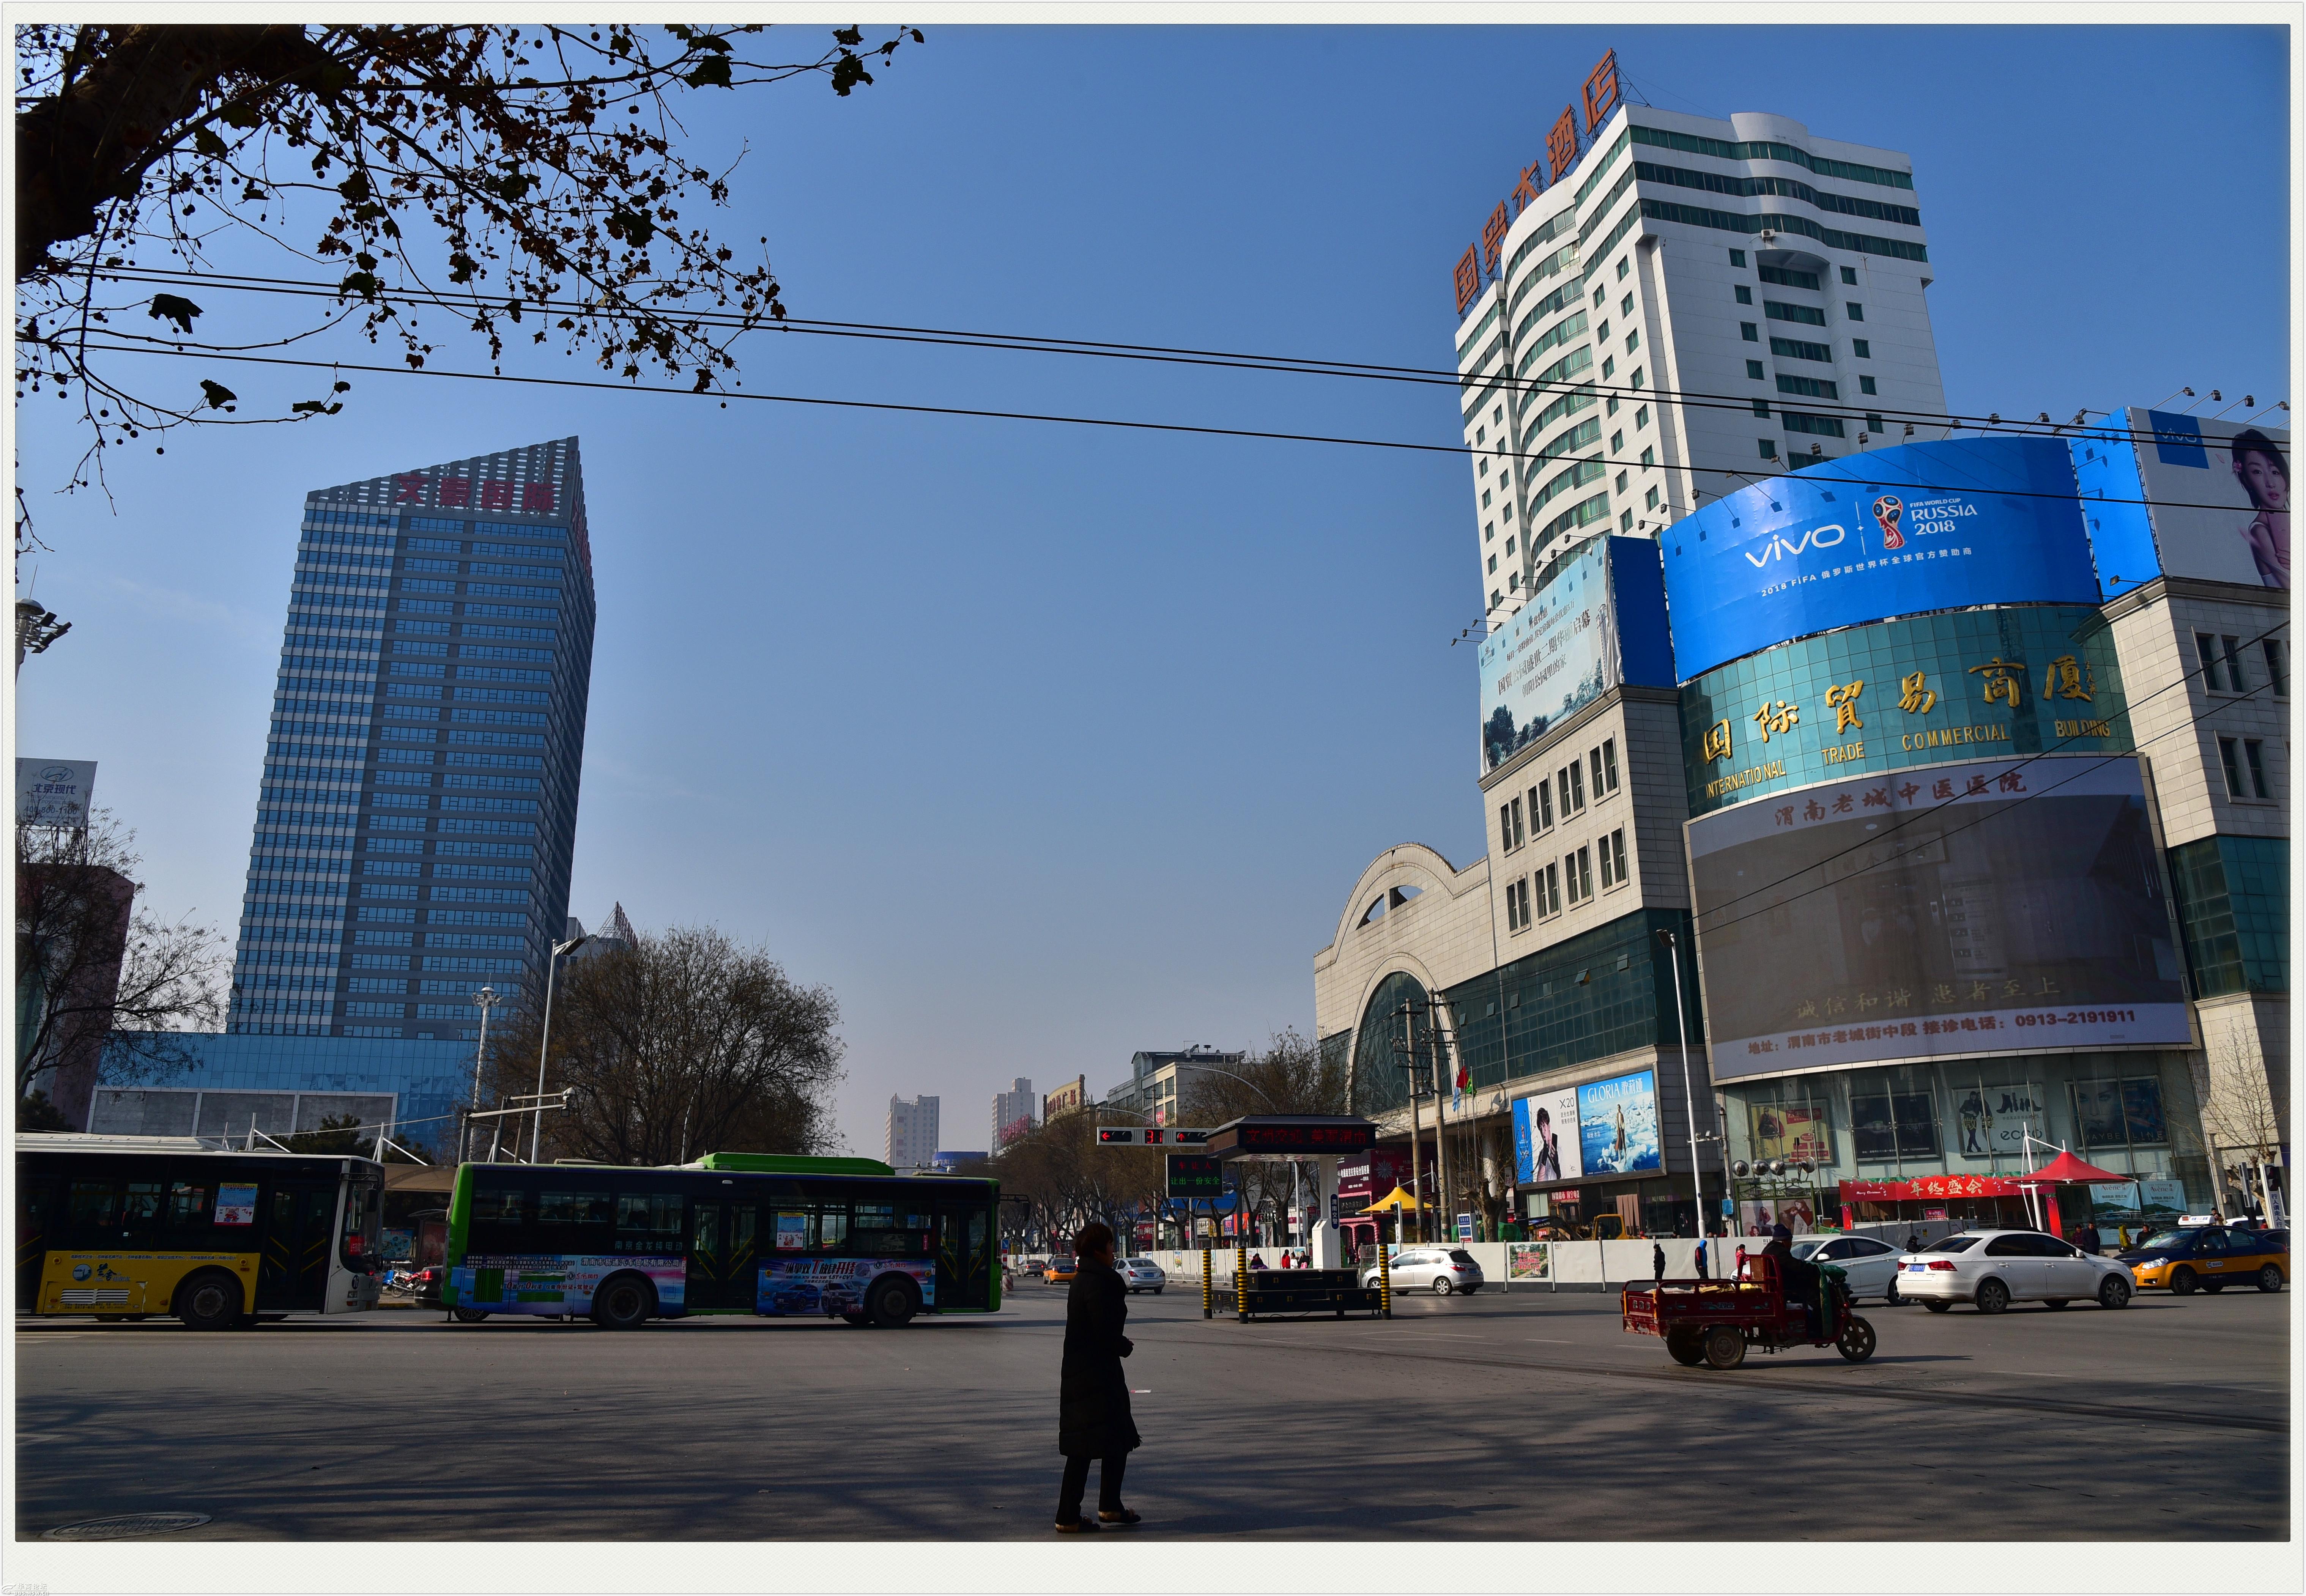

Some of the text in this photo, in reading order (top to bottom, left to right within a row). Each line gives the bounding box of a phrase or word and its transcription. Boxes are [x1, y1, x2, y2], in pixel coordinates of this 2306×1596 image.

[1453, 48, 1617, 318] 国贸大酒店
[1911, 504, 1978, 521] RUSSIA
[1915, 520, 1955, 535] 2018
[1745, 524, 1845, 568] vivo
[1761, 547, 1972, 597] 2018 FIFA 俄罗斯世界杯全球官方赞助商
[1528, 606, 1548, 631] 开盘特惠
[1498, 609, 1591, 696] 国贸公园盛世二期华丽启幕
[1522, 654, 1567, 698] 朝阳公园里的家
[1707, 718, 2111, 800] INTERNATIONAL TRADE COMMERCIAL BUILDING
[33, 783, 77, 795] 北京现代
[1775, 771, 2028, 827] 渭南老城中医医院
[1796, 977, 2060, 1019] 诚信和谐 患者至上
[1587, 1078, 1643, 1103] GLORIA 歌莉娅
[1559, 1097, 1574, 1109] X20
[1147, 1129, 1162, 1144] 31
[2000, 1129, 2043, 1140] ecco
[2084, 1131, 2163, 1142] MAYBELLINE
[1178, 1161, 1213, 1170] 车让人
[1910, 1179, 1983, 1196] 年终盛会
[615, 1241, 683, 1251] 南京金龙纯电动
[581, 1258, 679, 1267] 渭南市易通汽车贸易有限公司
[784, 1259, 857, 1274] 纵擎双T放肆开挂
